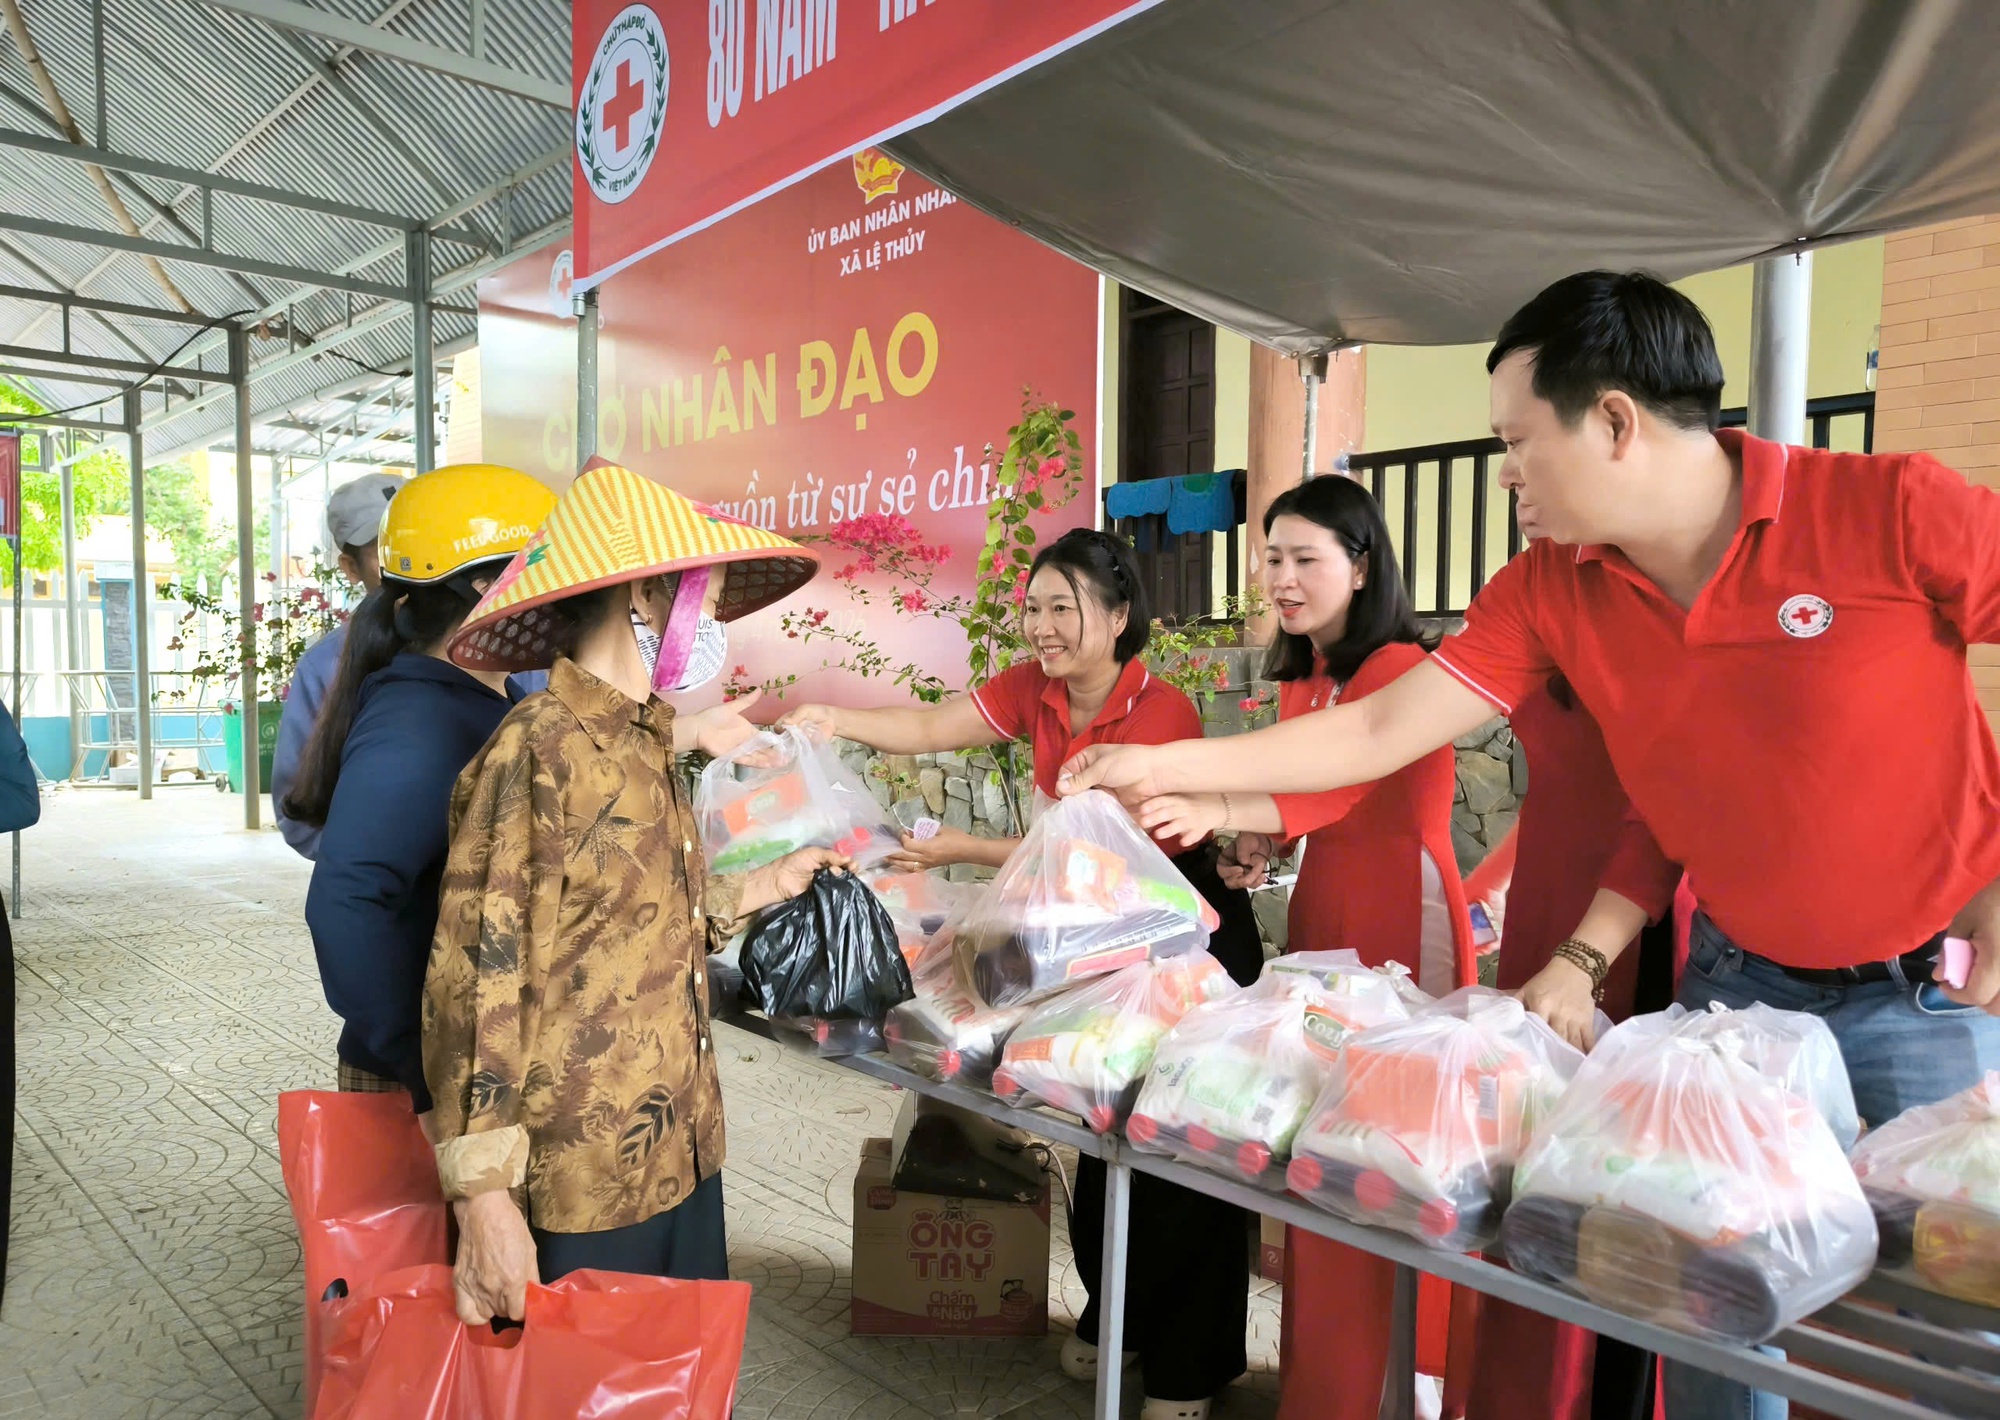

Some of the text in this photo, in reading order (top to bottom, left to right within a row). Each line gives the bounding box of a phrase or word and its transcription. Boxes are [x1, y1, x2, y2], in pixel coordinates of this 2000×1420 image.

[707, 0, 745, 128] 80
[622, 166, 638, 188] NAM
[807, 227, 827, 253] ỦY
[830, 218, 861, 247] BAN
[865, 199, 910, 234] NHÂN
[839, 227, 926, 277] XÃ LỆ THỦY
[641, 344, 777, 454] NHÂN
[796, 311, 939, 432] ĐẠO
[786, 472, 824, 529] từ
[878, 447, 917, 518] sẻ
[1304, 1014, 1344, 1048] Cozy
